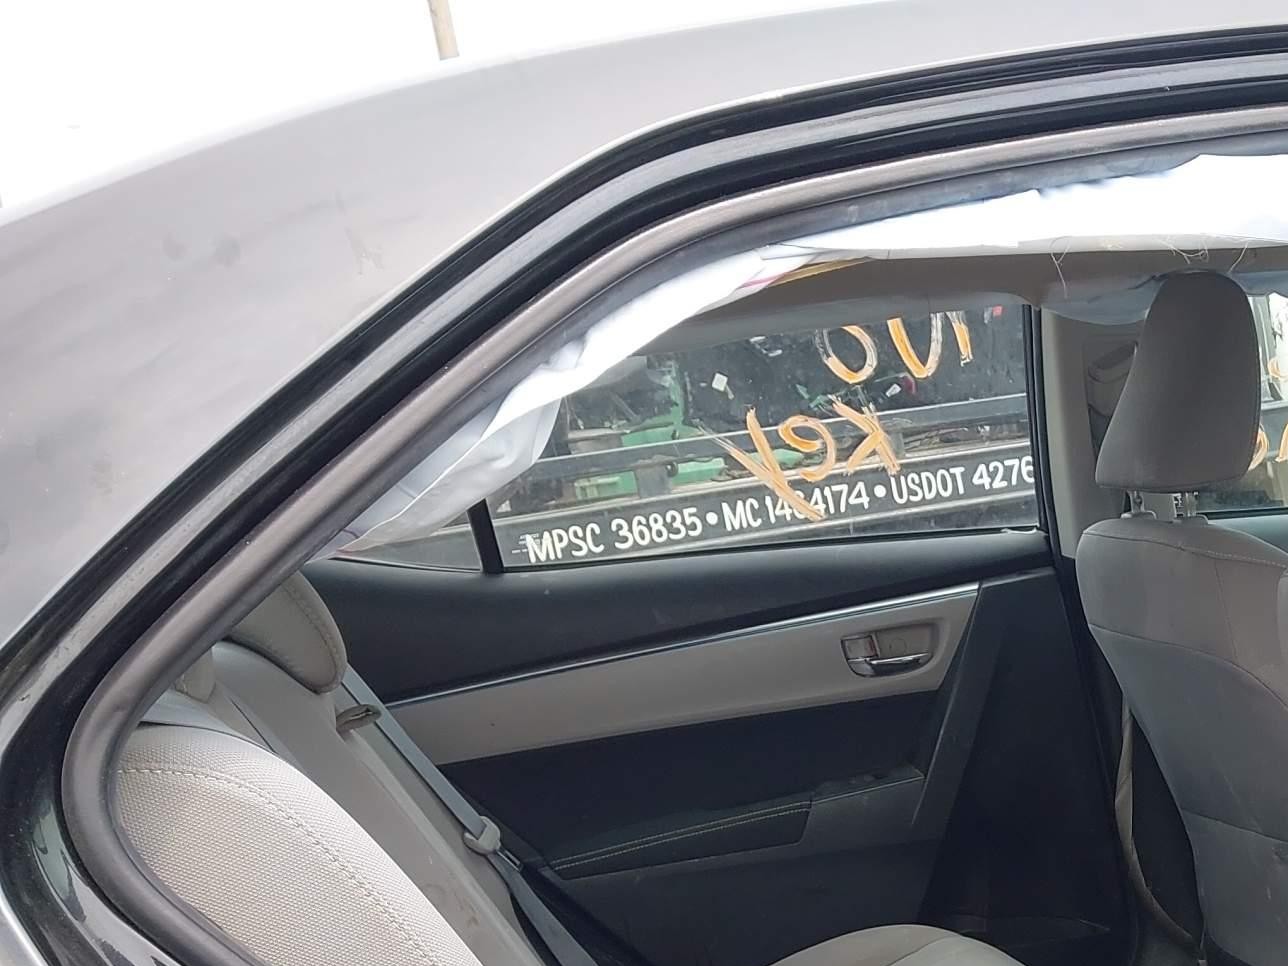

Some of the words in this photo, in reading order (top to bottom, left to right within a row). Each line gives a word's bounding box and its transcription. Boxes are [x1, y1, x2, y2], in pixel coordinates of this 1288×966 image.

[525, 522, 605, 564] MPSC
[610, 507, 703, 550] 36835
[721, 497, 762, 531] MC
[889, 466, 966, 504] USDOT
